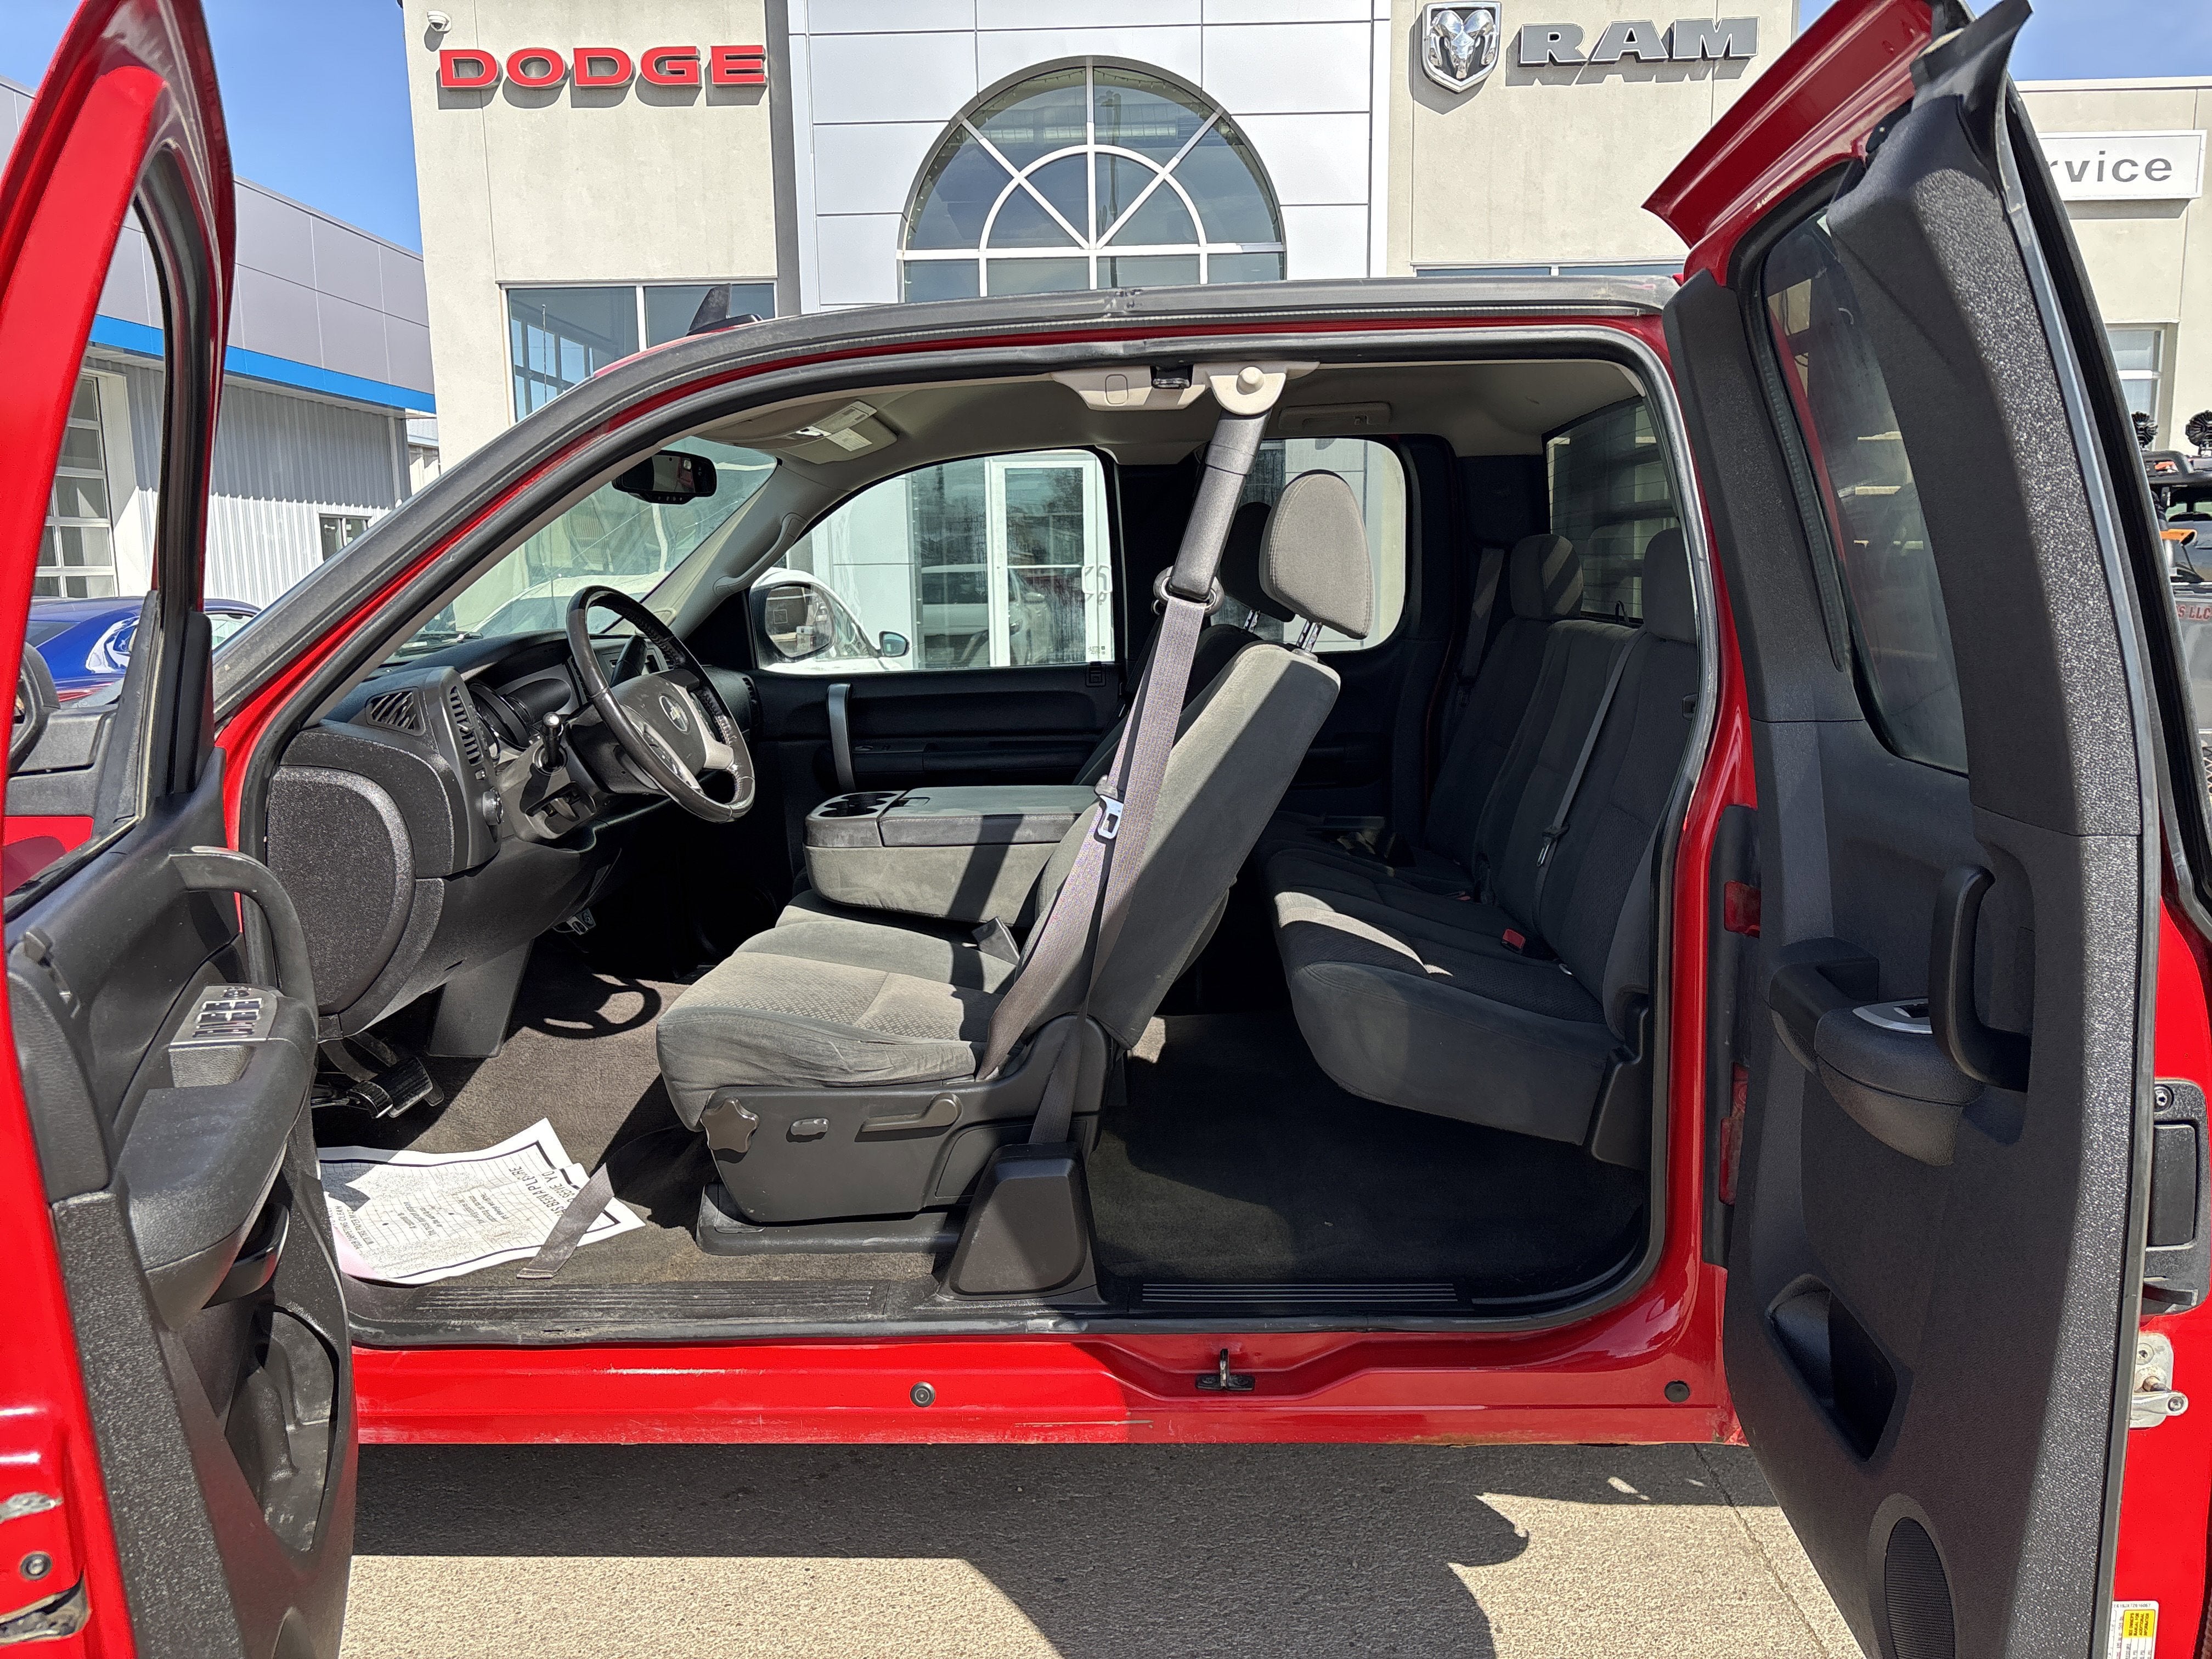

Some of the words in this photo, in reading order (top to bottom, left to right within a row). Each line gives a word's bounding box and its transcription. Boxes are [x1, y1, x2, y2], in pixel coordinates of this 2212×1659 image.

[1519, 16, 1760, 65] RAM
[438, 45, 767, 88] DODGE
[2046, 150, 2172, 182] vice
[2189, 606, 2211, 620] LLC
[549, 1183, 575, 1198] SERVE
[335, 1206, 346, 1221] CLEAN
